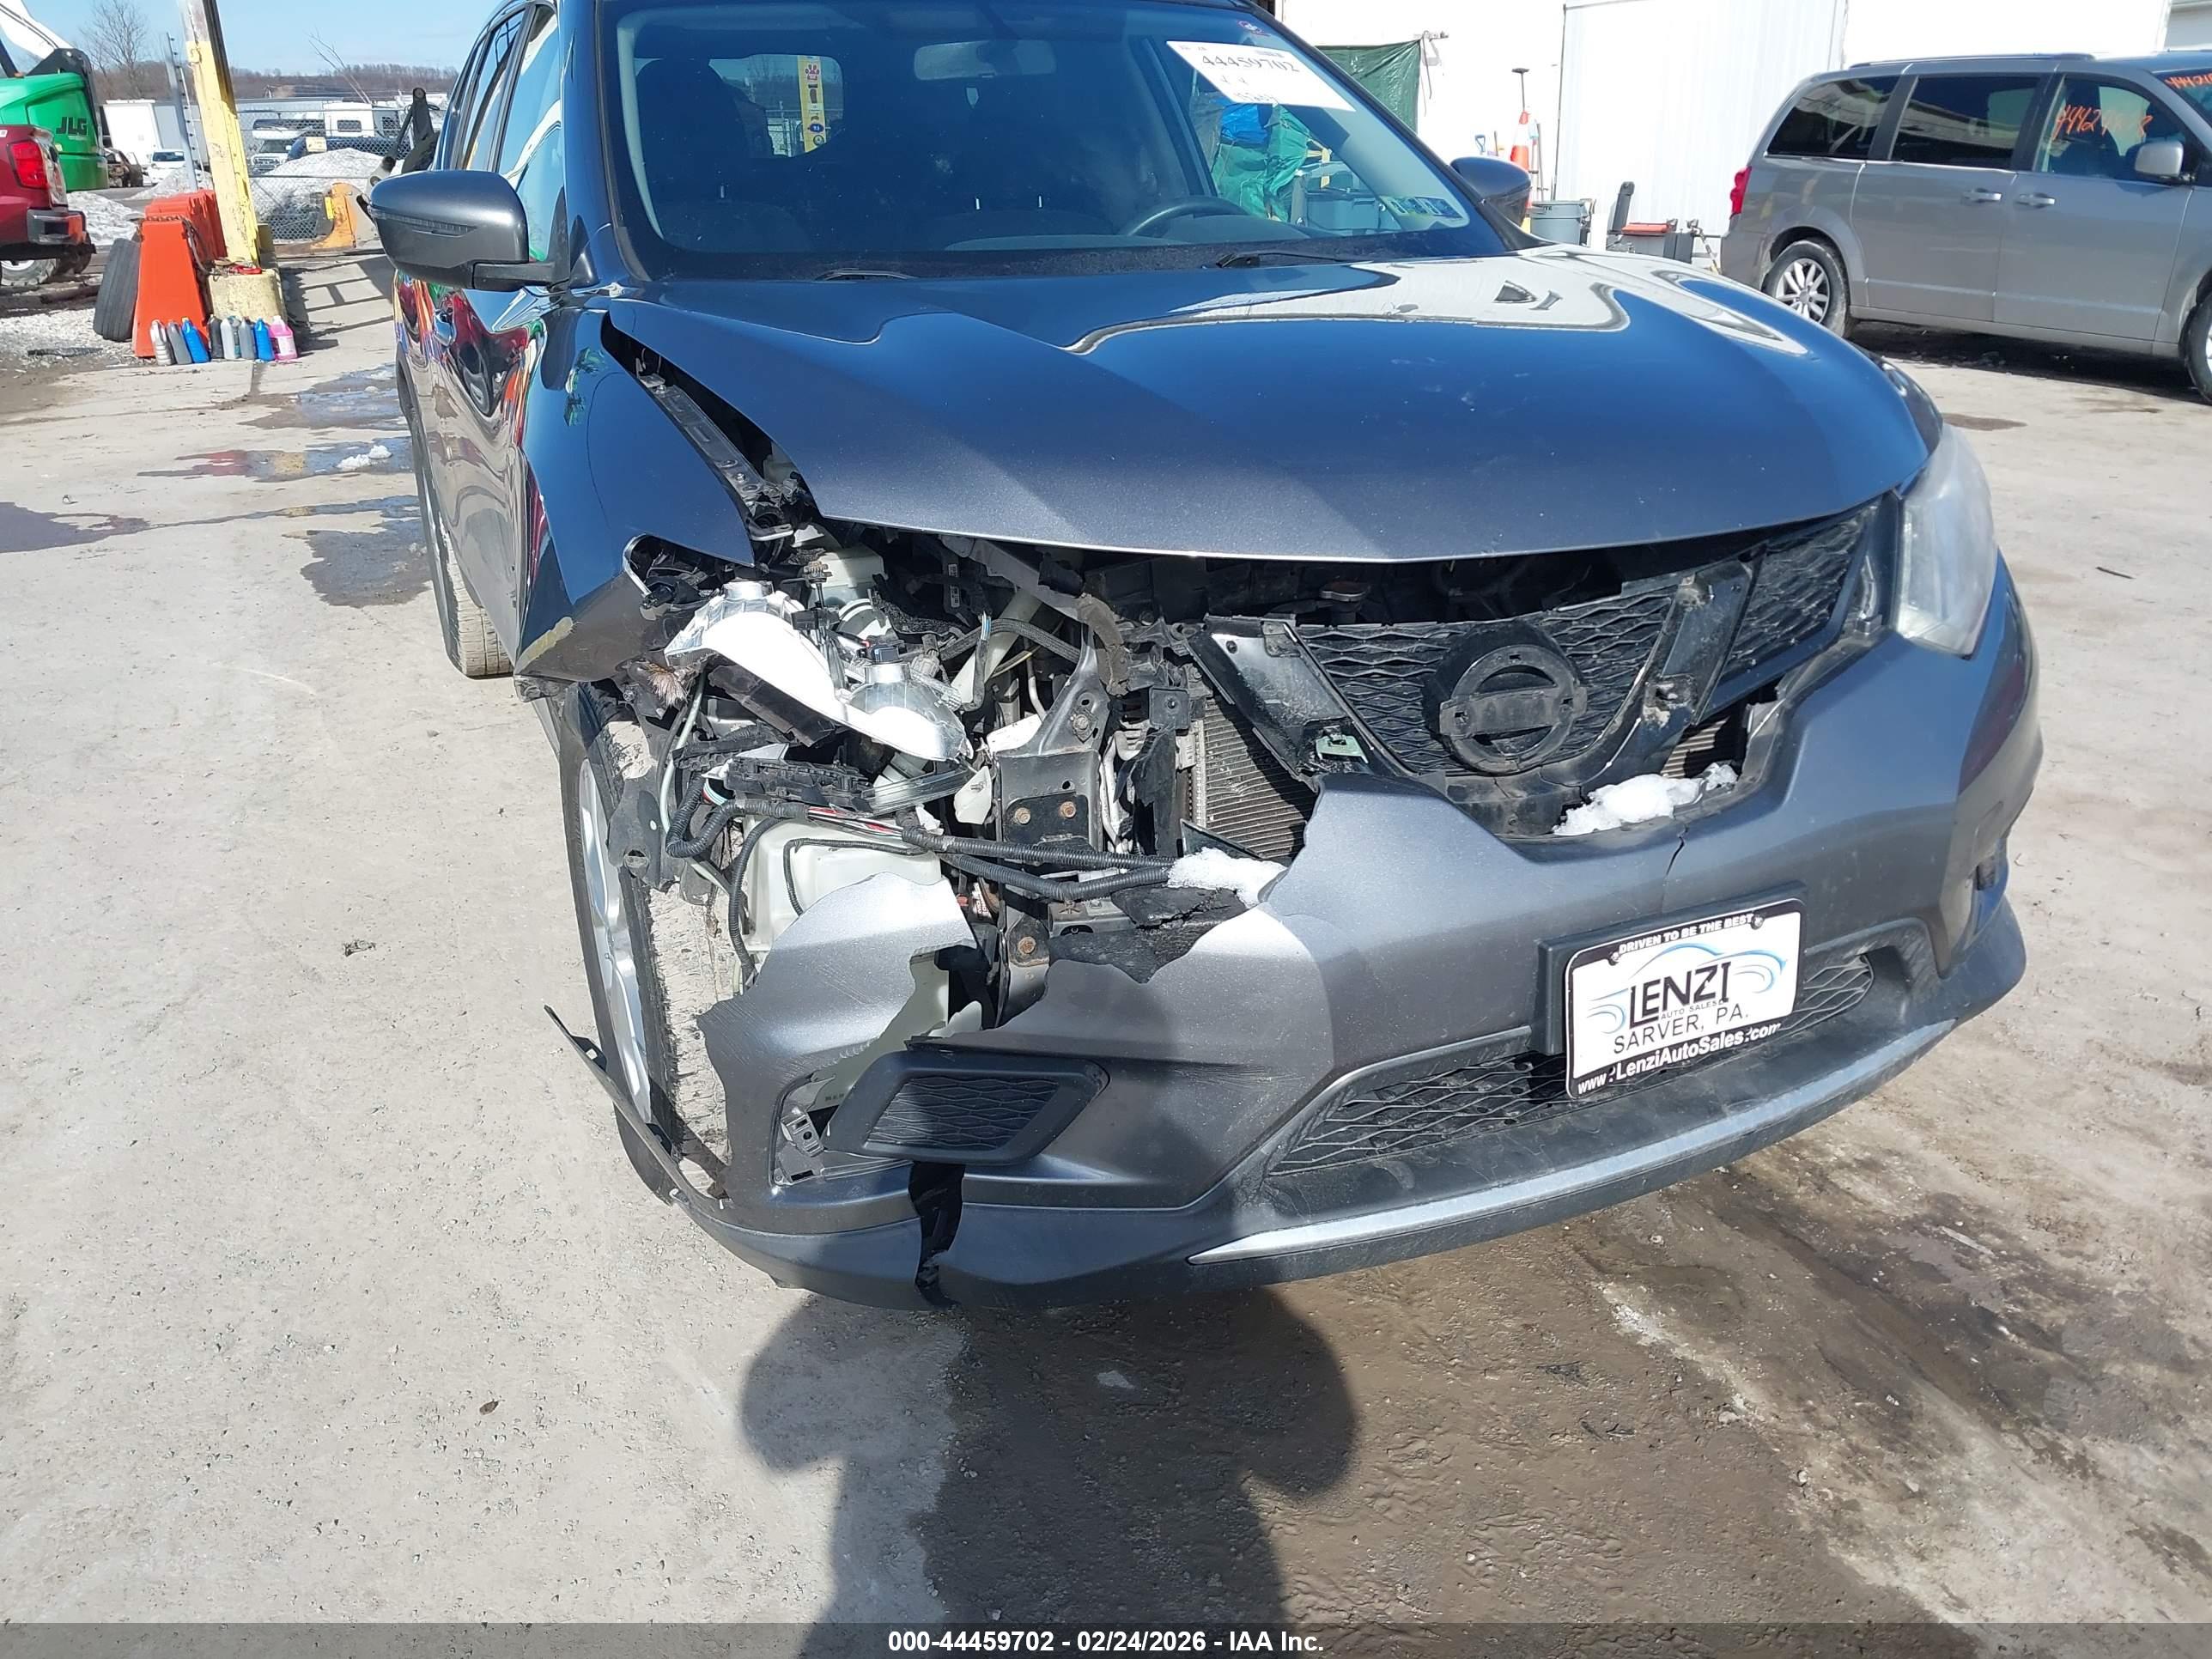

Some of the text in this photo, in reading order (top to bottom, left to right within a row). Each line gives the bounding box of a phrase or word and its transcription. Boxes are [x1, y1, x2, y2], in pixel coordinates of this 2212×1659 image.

[56, 116, 88, 136] JLG
[1619, 914, 1753, 954] DRIVEN TO BE THE BEST
[1630, 961, 1731, 1029] LENZI
[1661, 999, 1717, 1020] AUTO SALES
[1613, 1002, 1749, 1054] SARVER, PA.
